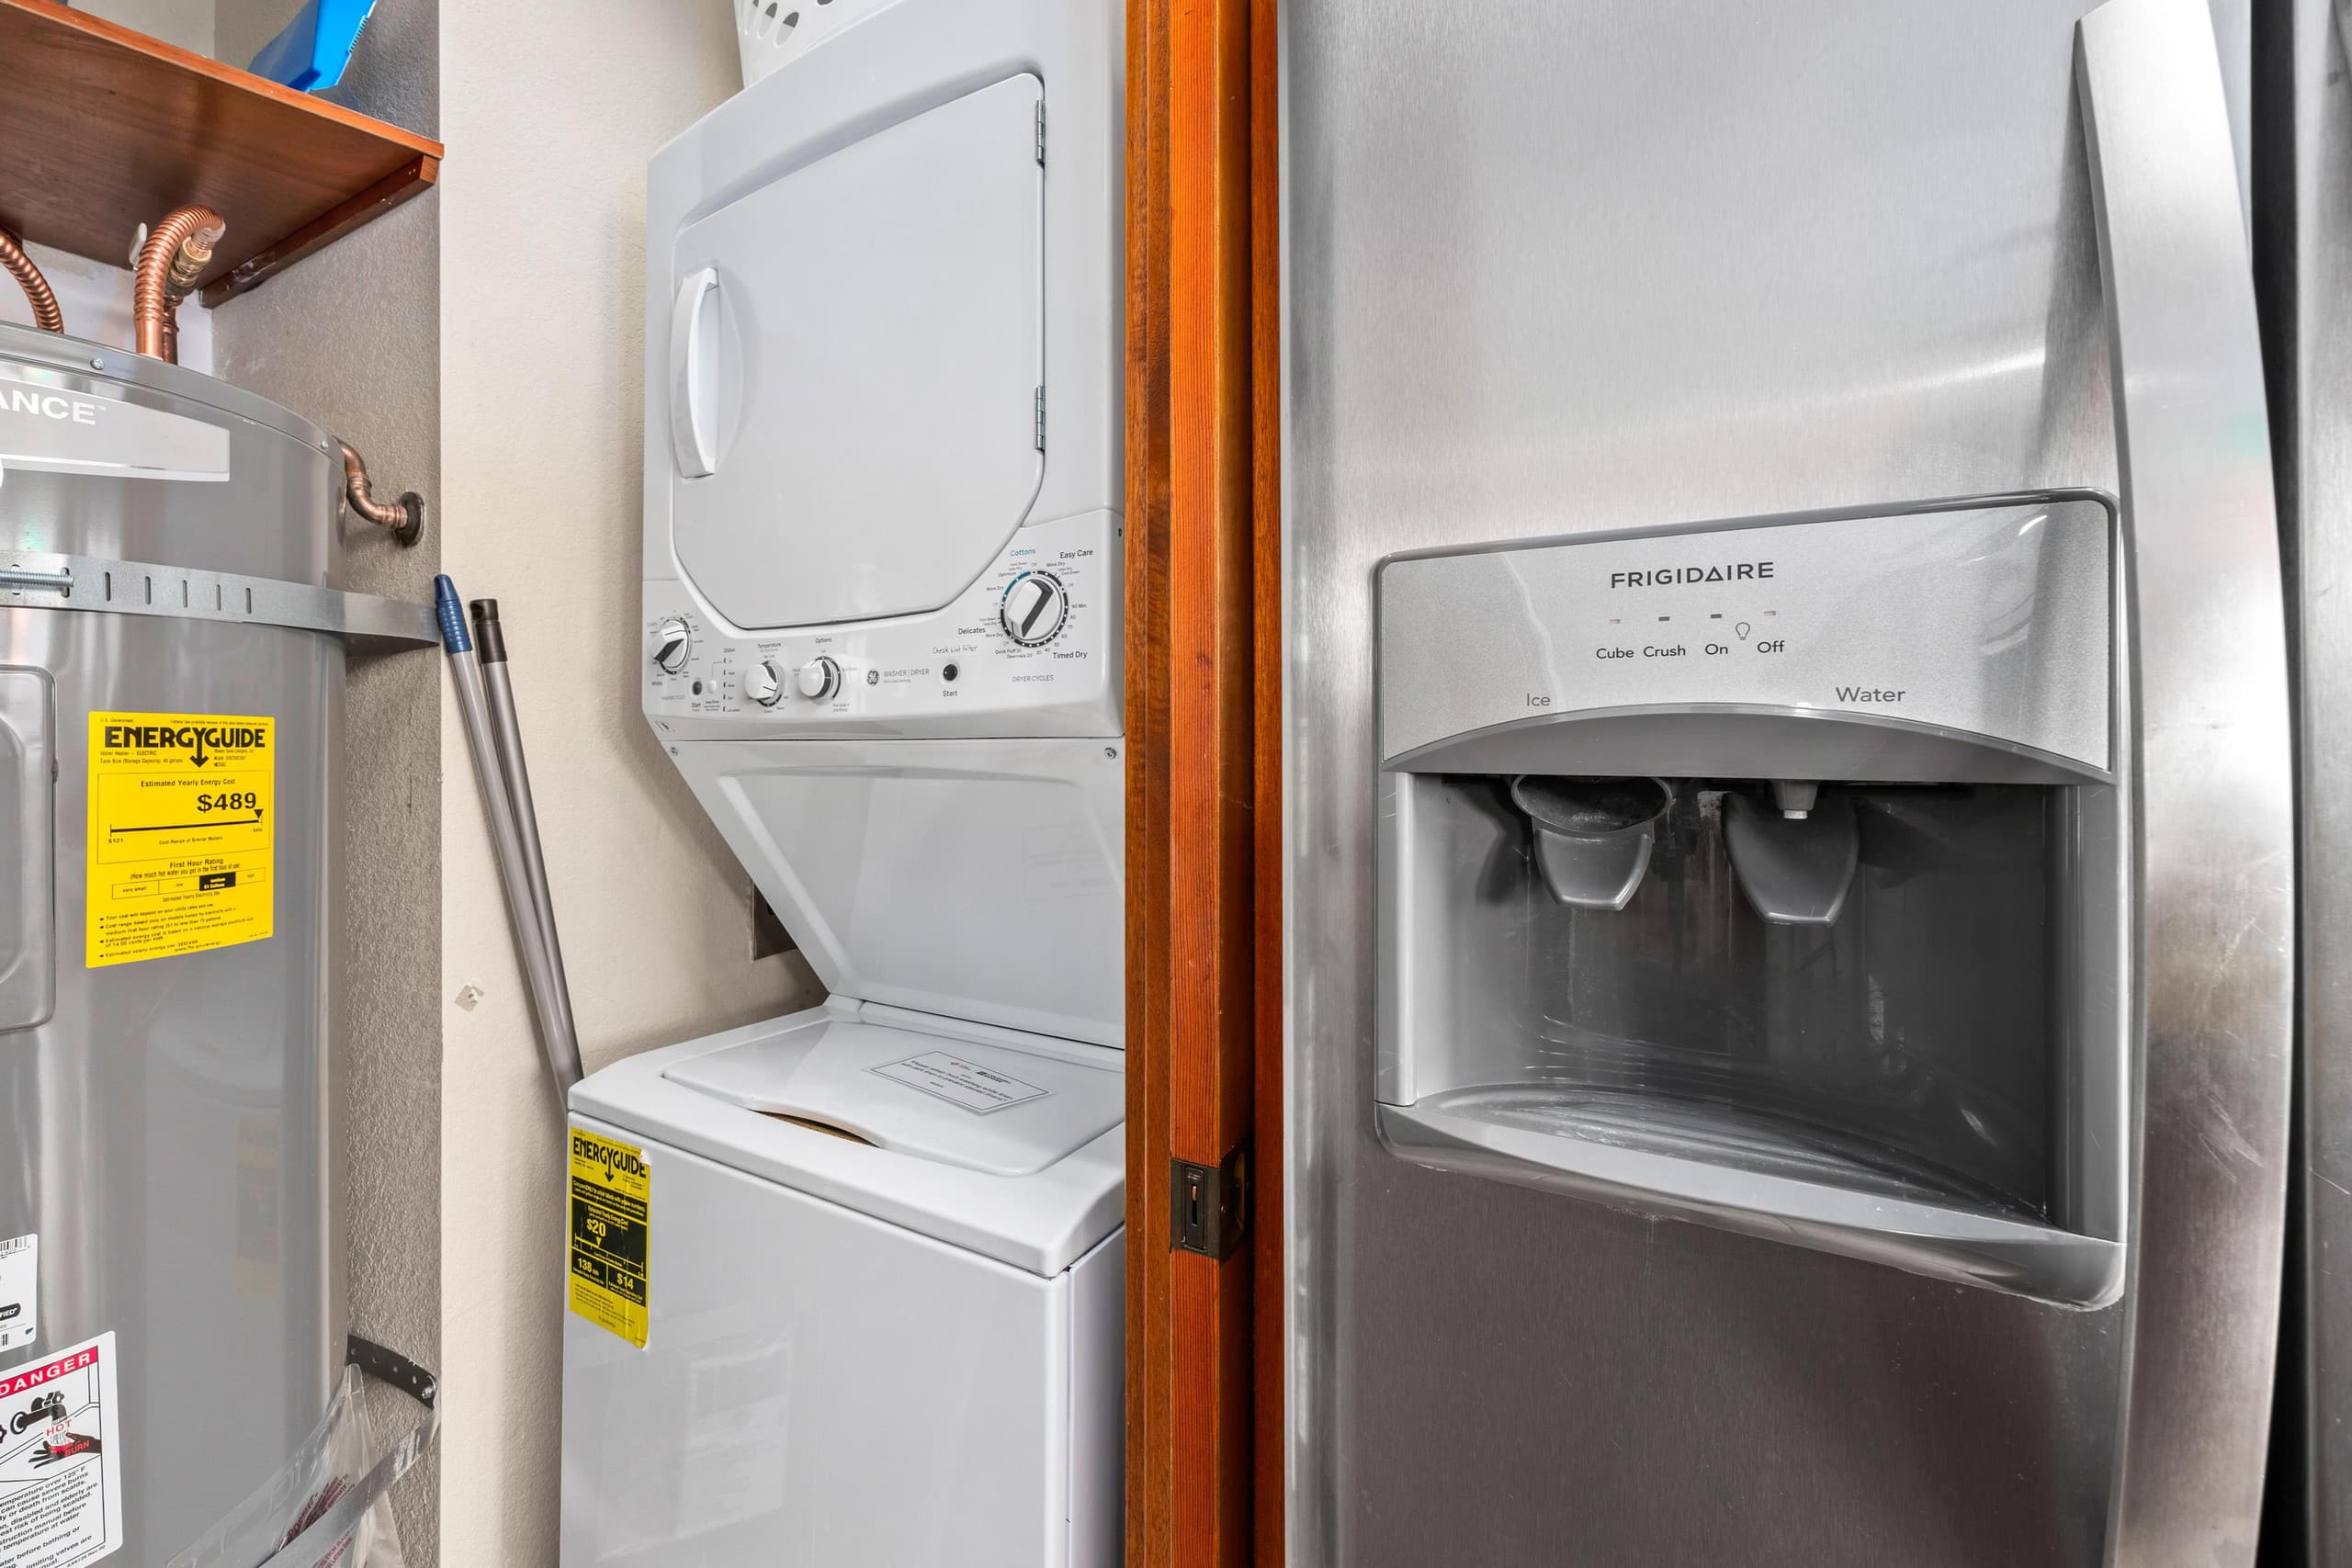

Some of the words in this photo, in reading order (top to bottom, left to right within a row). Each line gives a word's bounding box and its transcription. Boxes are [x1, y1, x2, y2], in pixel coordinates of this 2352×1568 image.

[1611, 561, 1774, 589] FRIGIDAIRE
[1075, 650, 1088, 659] Dry
[1596, 648, 1634, 660] Cube
[1643, 645, 1686, 658] Crush
[1704, 644, 1728, 655] On
[1757, 640, 1785, 653] Off
[1526, 693, 1551, 706] Ice
[1836, 686, 1905, 703] Water
[105, 727, 266, 749] ENERGYGUIDE
[141, 780, 175, 788] Estimated
[197, 792, 256, 814] $489
[573, 1136, 647, 1179] ENERGYGUIDE
[587, 1219, 605, 1237] $20
[578, 1258, 593, 1272] 138
[616, 1273, 634, 1290] $14
[0, 1353, 90, 1396] DANGER
[46, 1419, 73, 1437] HOT
[64, 1439, 90, 1456] BURN
[1, 1505, 15, 1514] can
[17, 1494, 40, 1507] cause
[41, 1483, 66, 1496] severe
[68, 1472, 88, 1484] burns
[45, 1478, 62, 1489] over
[8, 1509, 17, 1517] or
[18, 1498, 40, 1513] death
[42, 1492, 60, 1503] from
[61, 1481, 86, 1494] scalds.
[11, 1506, 44, 1526] disabled
[44, 1500, 59, 1511] and
[61, 1487, 85, 1504] elderly
[86, 1482, 97, 1491] are
[14, 1520, 28, 1530] risk
[30, 1516, 39, 1524] of
[40, 1506, 61, 1519] being
[62, 1492, 93, 1508] scalded.
[34, 1514, 62, 1530] manual
[63, 1502, 86, 1517] before
[4, 1527, 50, 1551] temperature
[51, 1521, 58, 1529] at
[60, 1512, 80, 1525] water
[17, 1545, 41, 1560] before
[43, 1530, 71, 1548] bathing
[56, 1542, 79, 1556] valves
[81, 1535, 92, 1544] are
